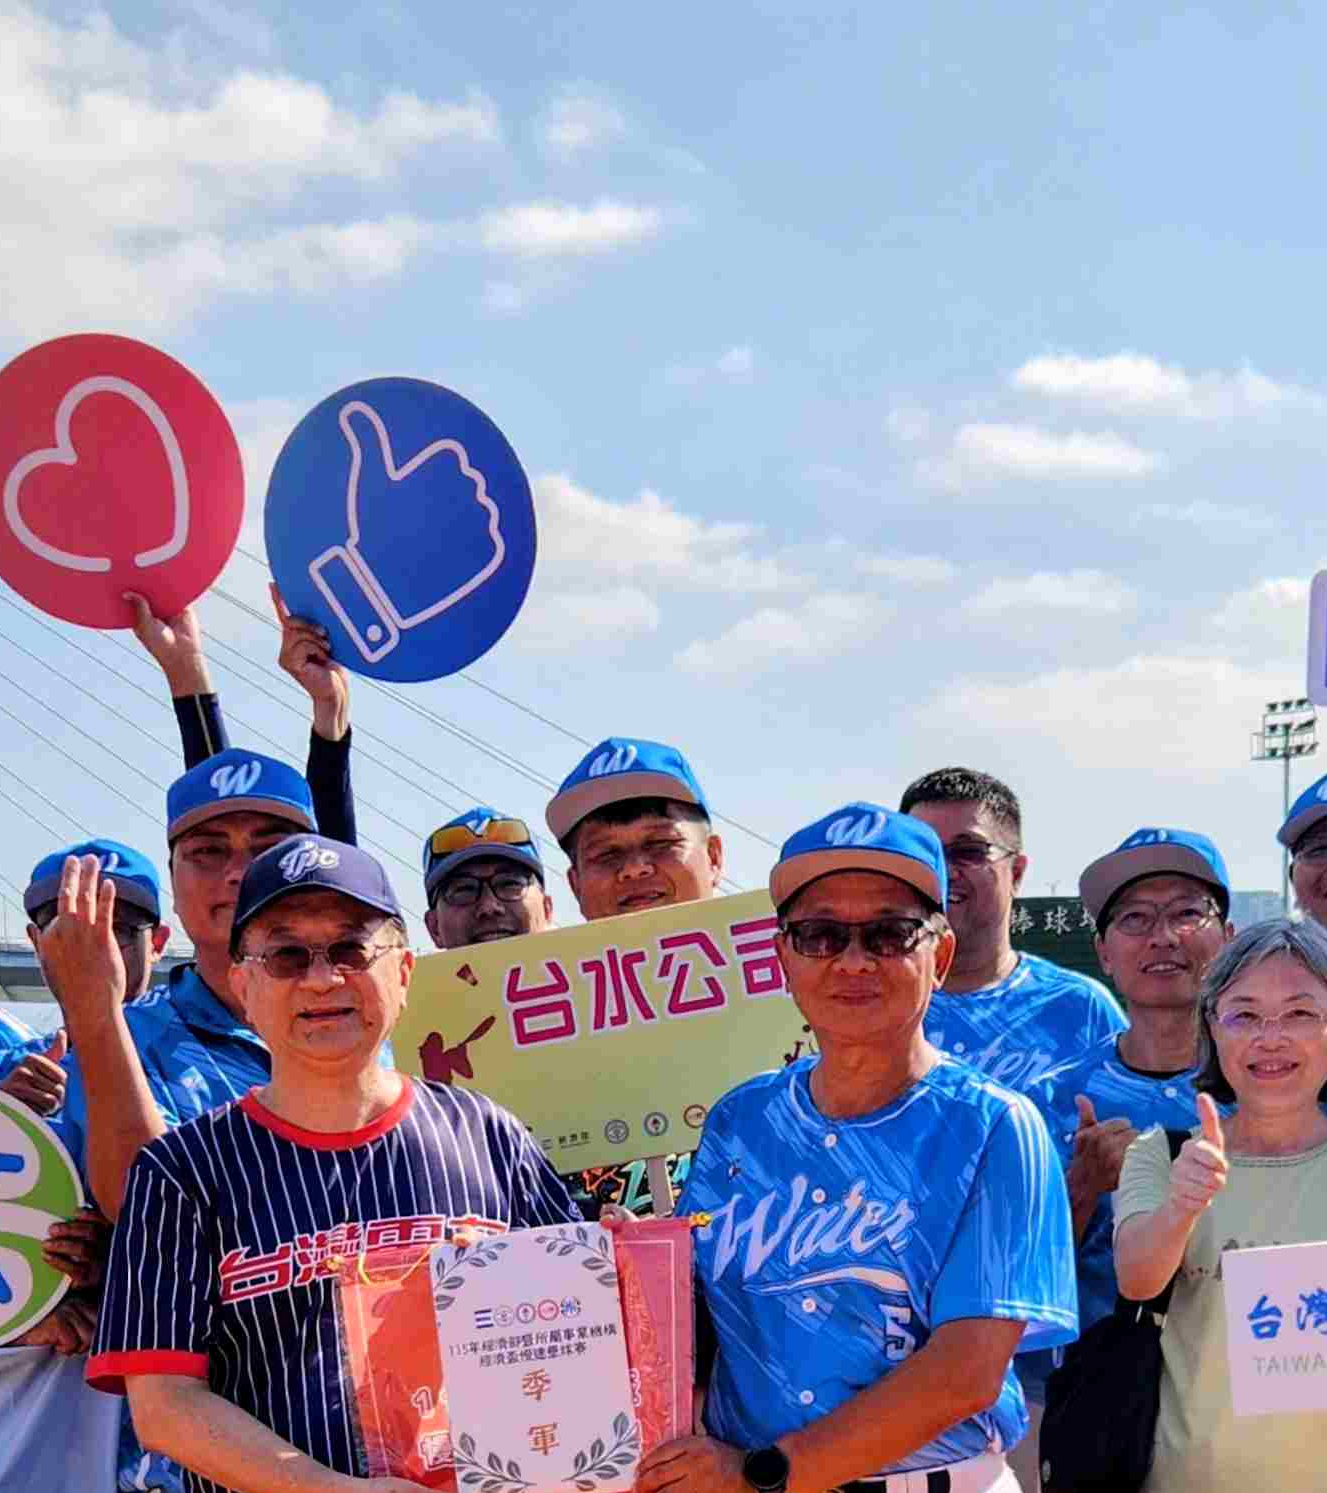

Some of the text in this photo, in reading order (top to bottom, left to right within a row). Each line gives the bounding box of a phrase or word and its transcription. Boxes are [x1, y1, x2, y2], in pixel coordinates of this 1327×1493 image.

[211, 760, 262, 795] W
[825, 806, 887, 847] W
[506, 916, 785, 1046] 台水公司
[697, 1174, 916, 1283] Water
